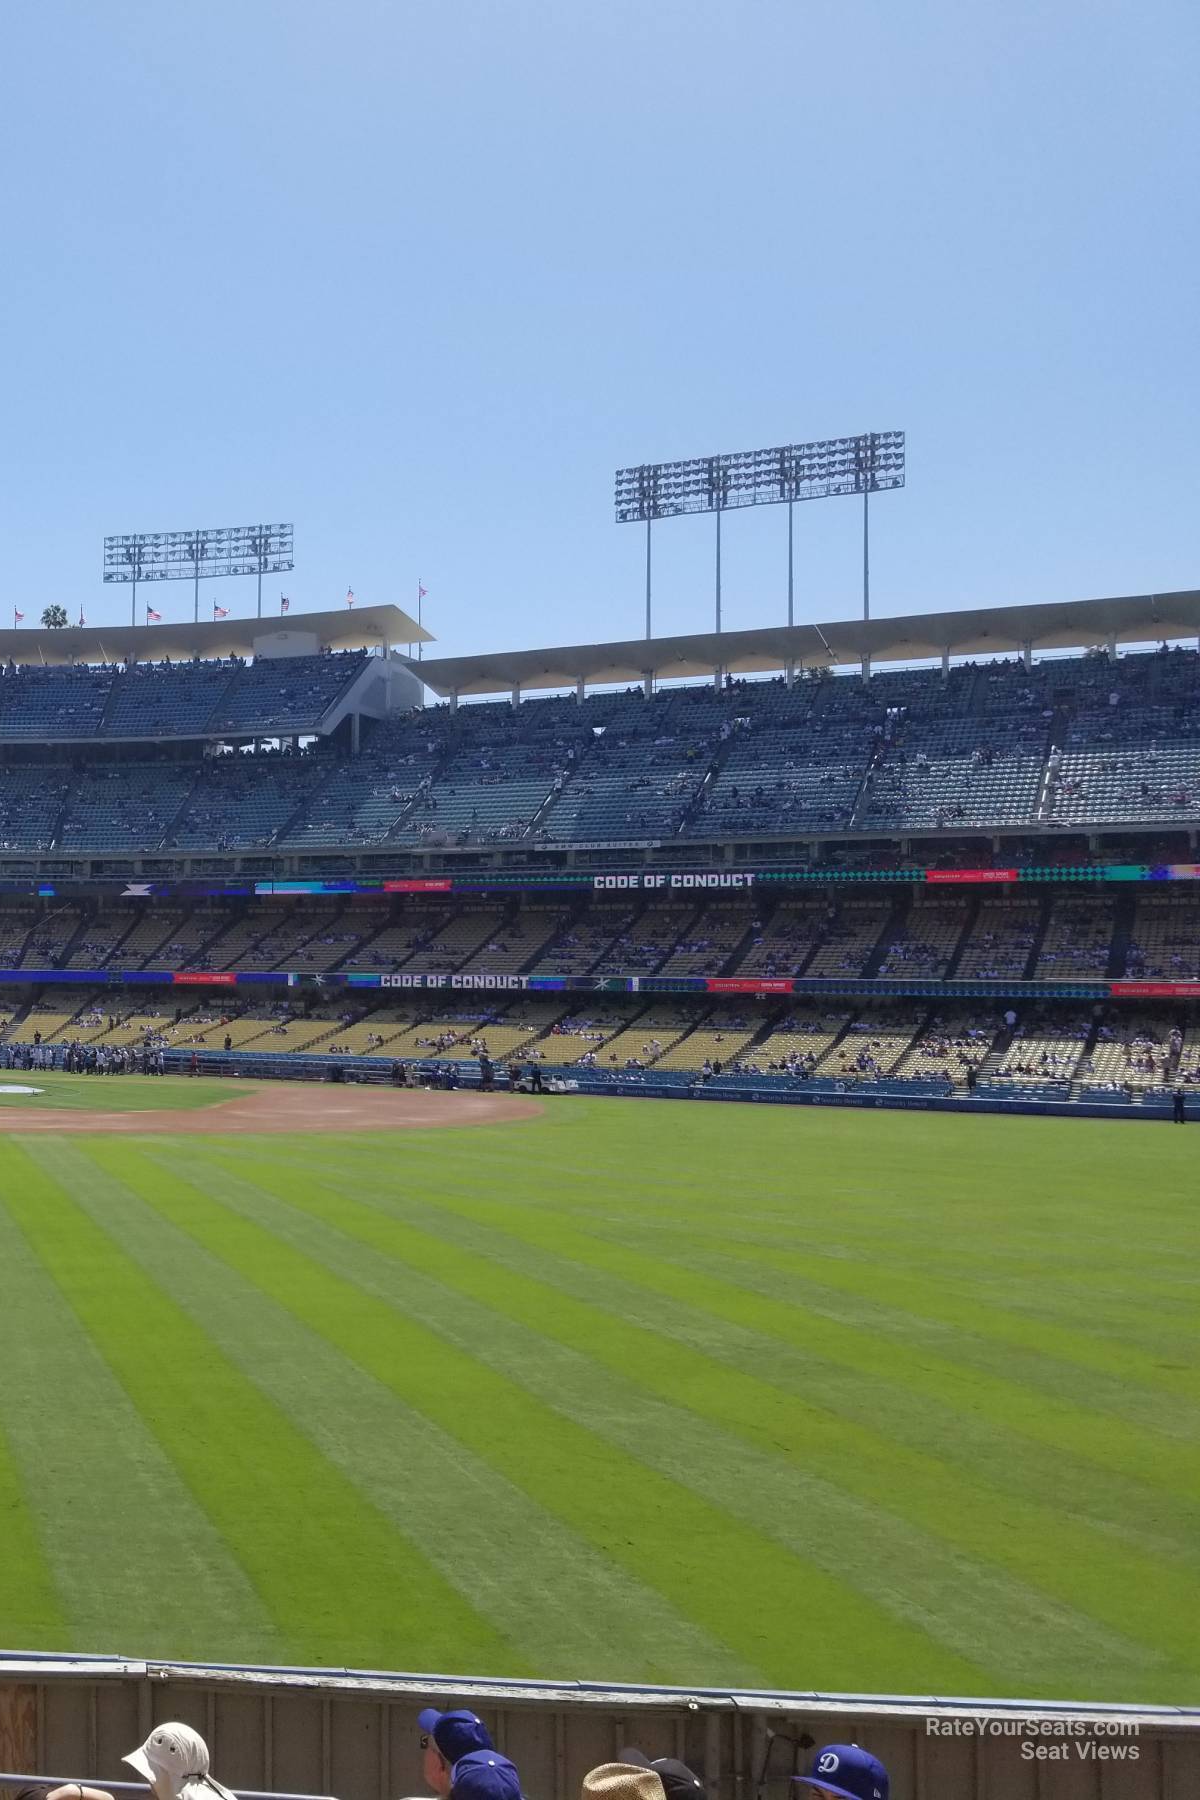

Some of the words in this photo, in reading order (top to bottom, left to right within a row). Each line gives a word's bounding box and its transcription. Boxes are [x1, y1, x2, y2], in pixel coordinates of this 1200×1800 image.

[593, 876, 639, 889] CODE
[643, 874, 666, 888] OF
[671, 873, 755, 888] CONDUCT
[381, 975, 422, 988] CODE
[427, 975, 447, 988] OF
[451, 976, 529, 989] CONDUCT
[817, 1752, 840, 1773] D
